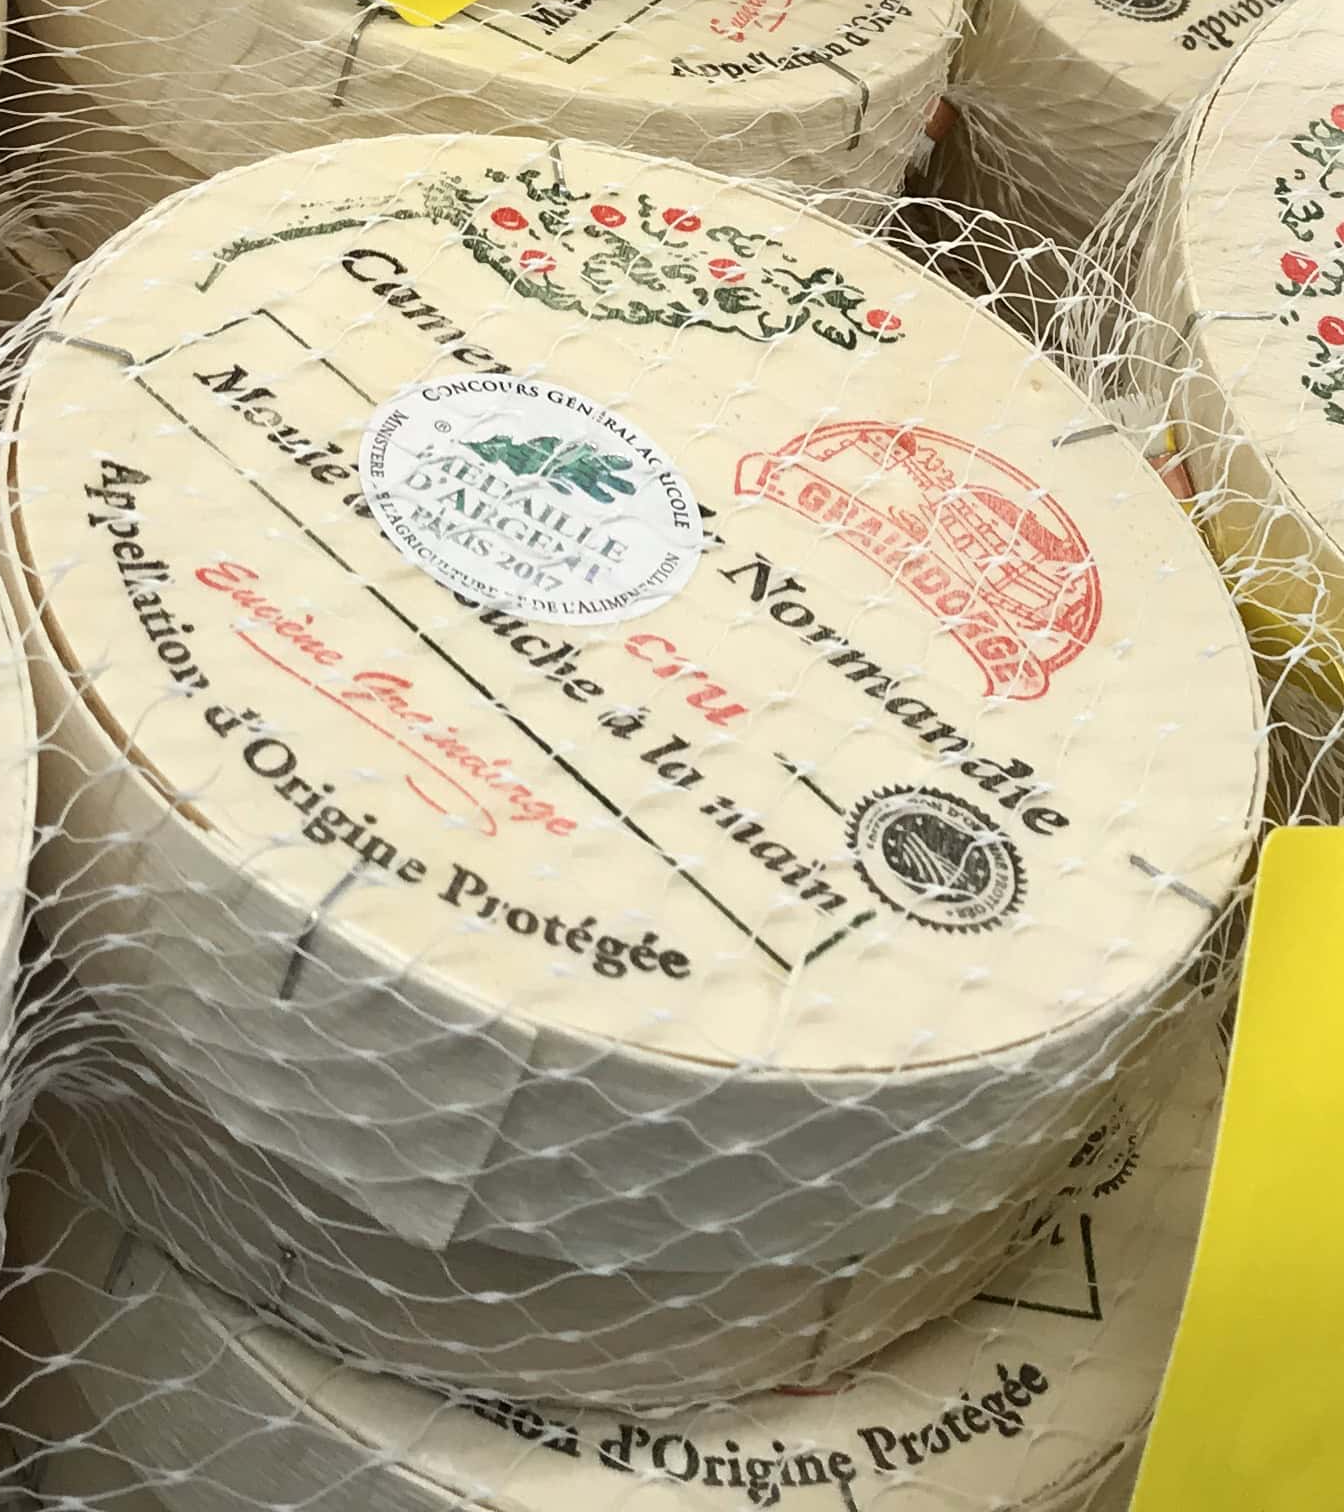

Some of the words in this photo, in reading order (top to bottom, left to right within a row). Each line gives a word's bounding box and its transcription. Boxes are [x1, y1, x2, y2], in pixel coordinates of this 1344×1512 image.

[496, 552, 564, 591] 2017
[85, 456, 212, 699] Appellation
[205, 702, 428, 885] d'Origine
[437, 860, 693, 983] Protégée
[620, 630, 749, 727] cru
[716, 552, 1070, 838] Normandie
[597, 696, 646, 740] à
[638, 732, 703, 793] la
[699, 794, 855, 915] main
[596, 1408, 859, 1507] d'Origine
[858, 1360, 1048, 1472] Protégée
